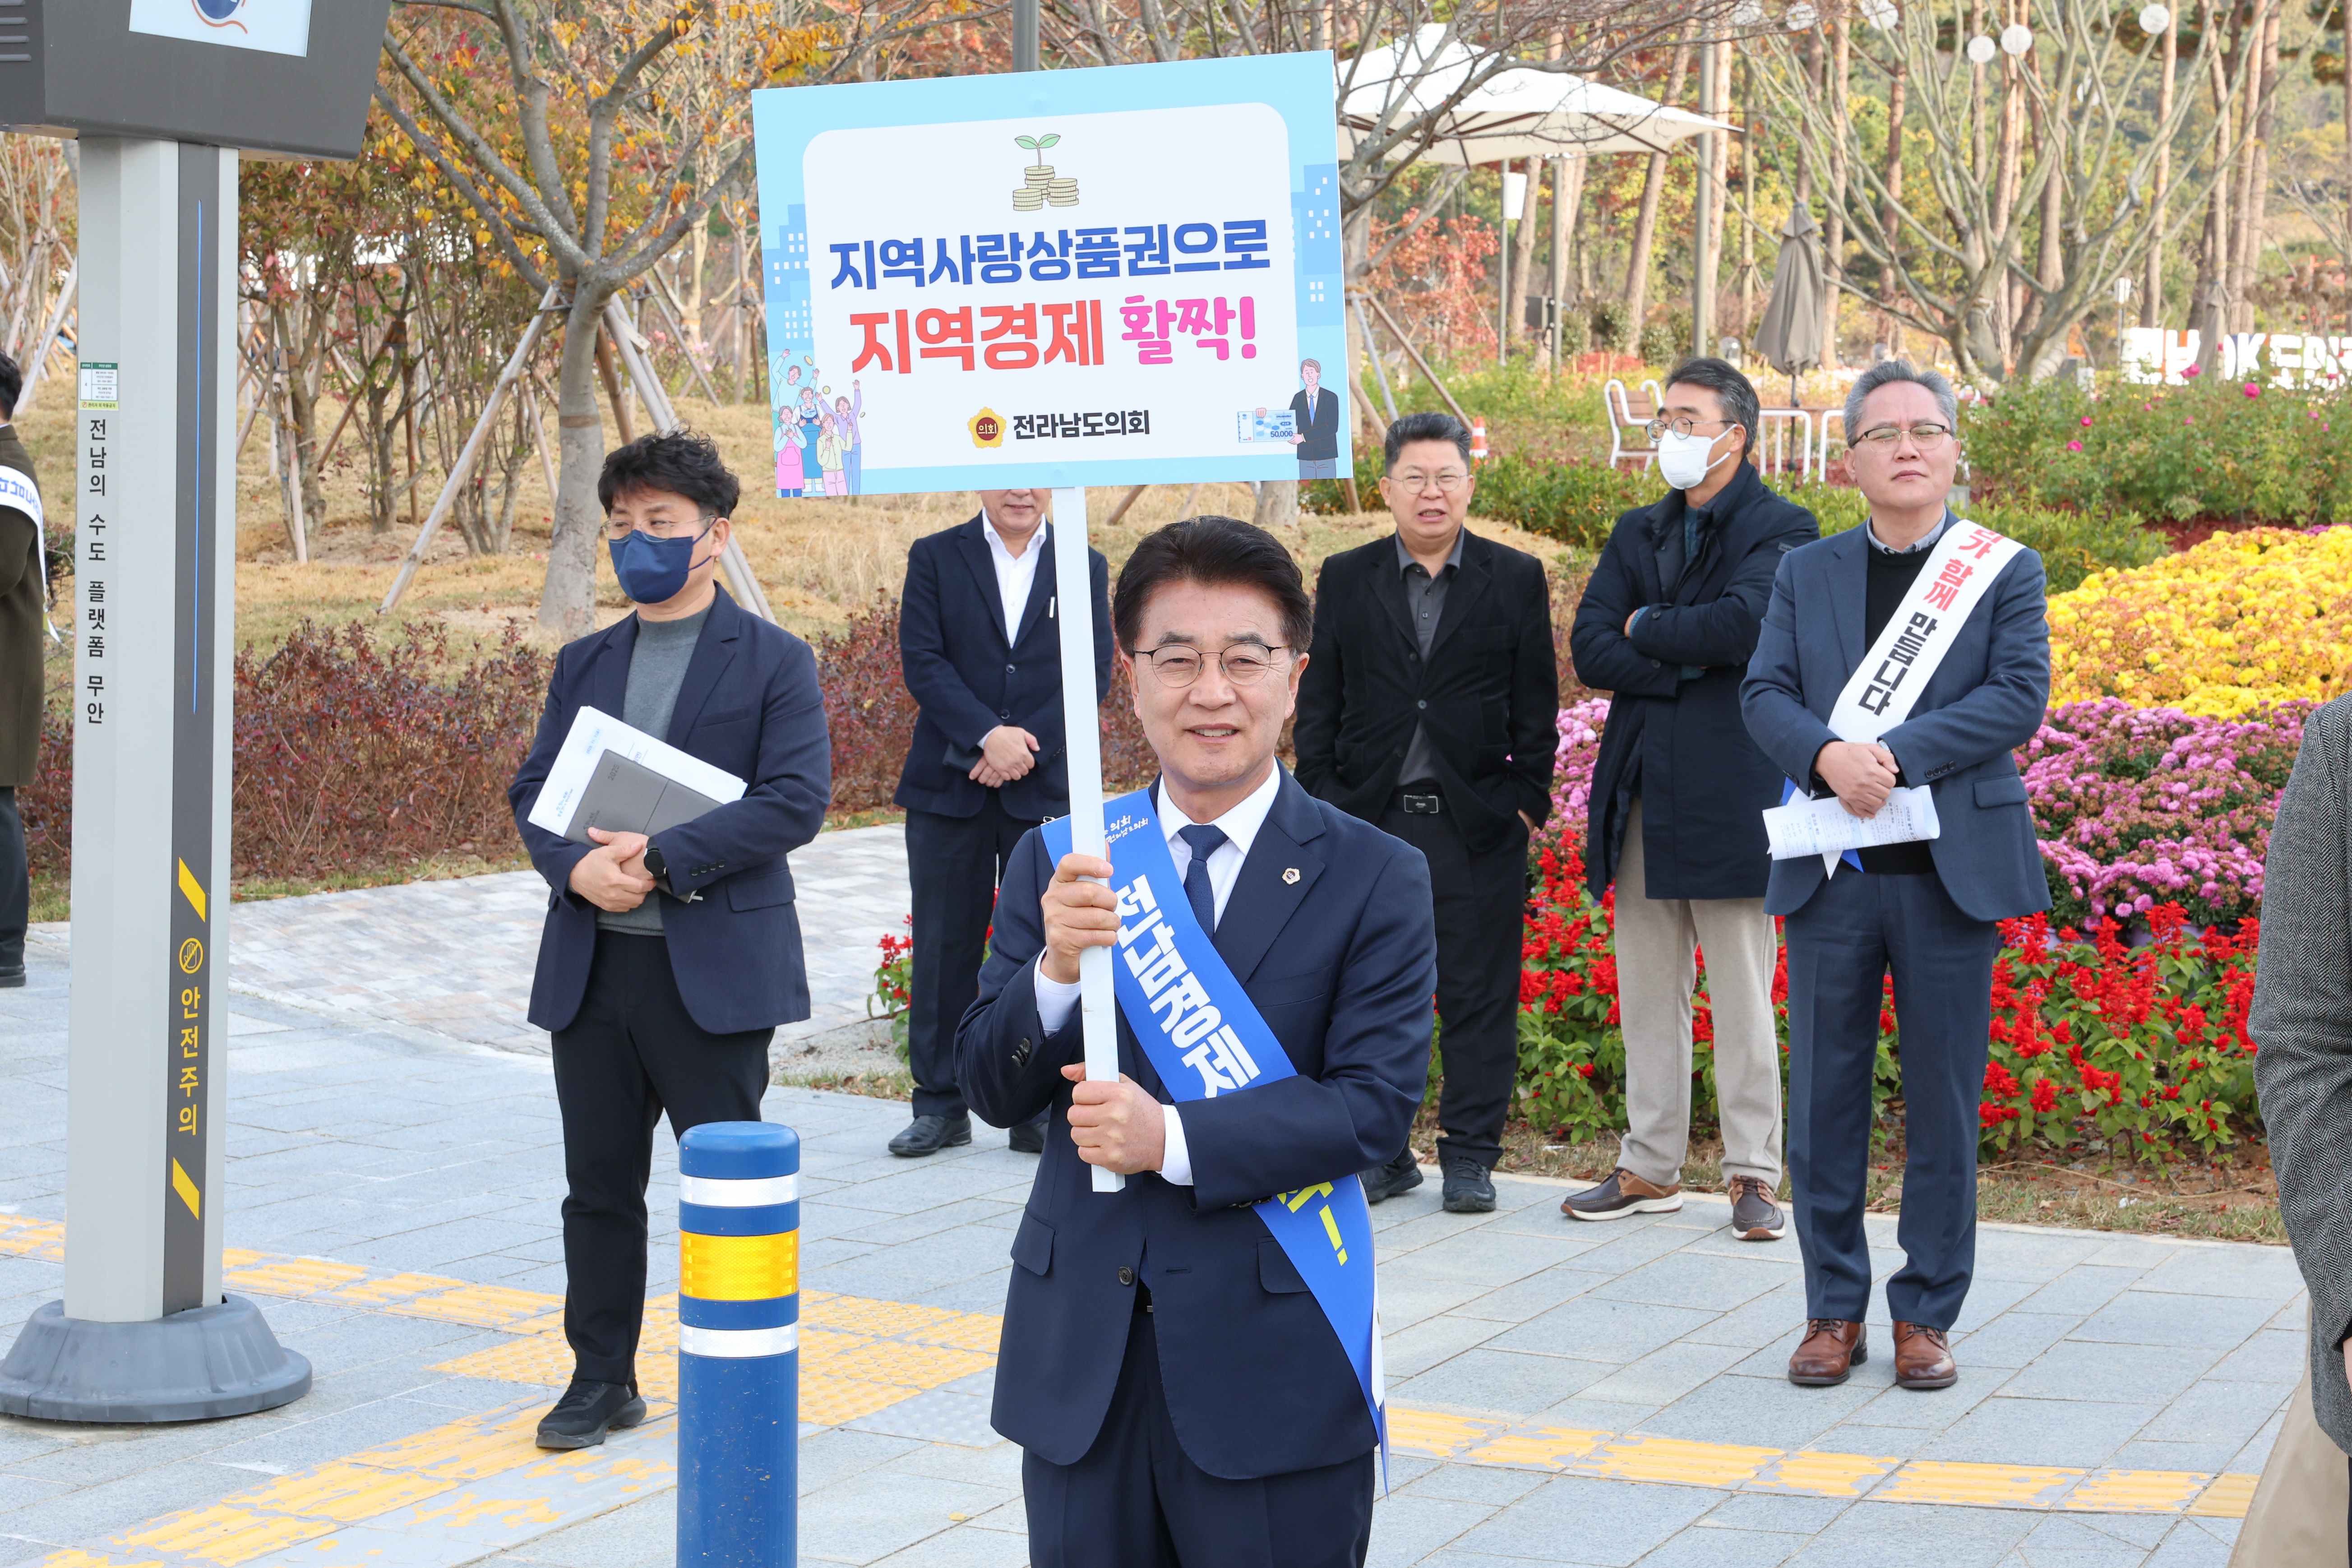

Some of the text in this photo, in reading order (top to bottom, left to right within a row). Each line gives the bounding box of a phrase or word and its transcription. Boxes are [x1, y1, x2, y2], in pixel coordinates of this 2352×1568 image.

[829, 219, 1270, 290] 지역사랑상품권으로
[850, 295, 1257, 374] 지역경제 활짝!
[978, 423, 997, 434] 의회
[1013, 410, 1150, 439] 전라남도의회
[89, 419, 106, 496] 전남의
[88, 514, 106, 561] 수도
[1923, 559, 1973, 611] 함께
[88, 581, 106, 658] 플랫폼
[1858, 612, 1937, 716] 만듭니다
[87, 675, 104, 724] 무안
[607, 763, 620, 781] 2025
[1106, 818, 1149, 844] 전라남도의회
[1109, 815, 1131, 832] 의회
[1115, 874, 1261, 1098] 전남경제
[179, 987, 201, 1135] 안전주의
